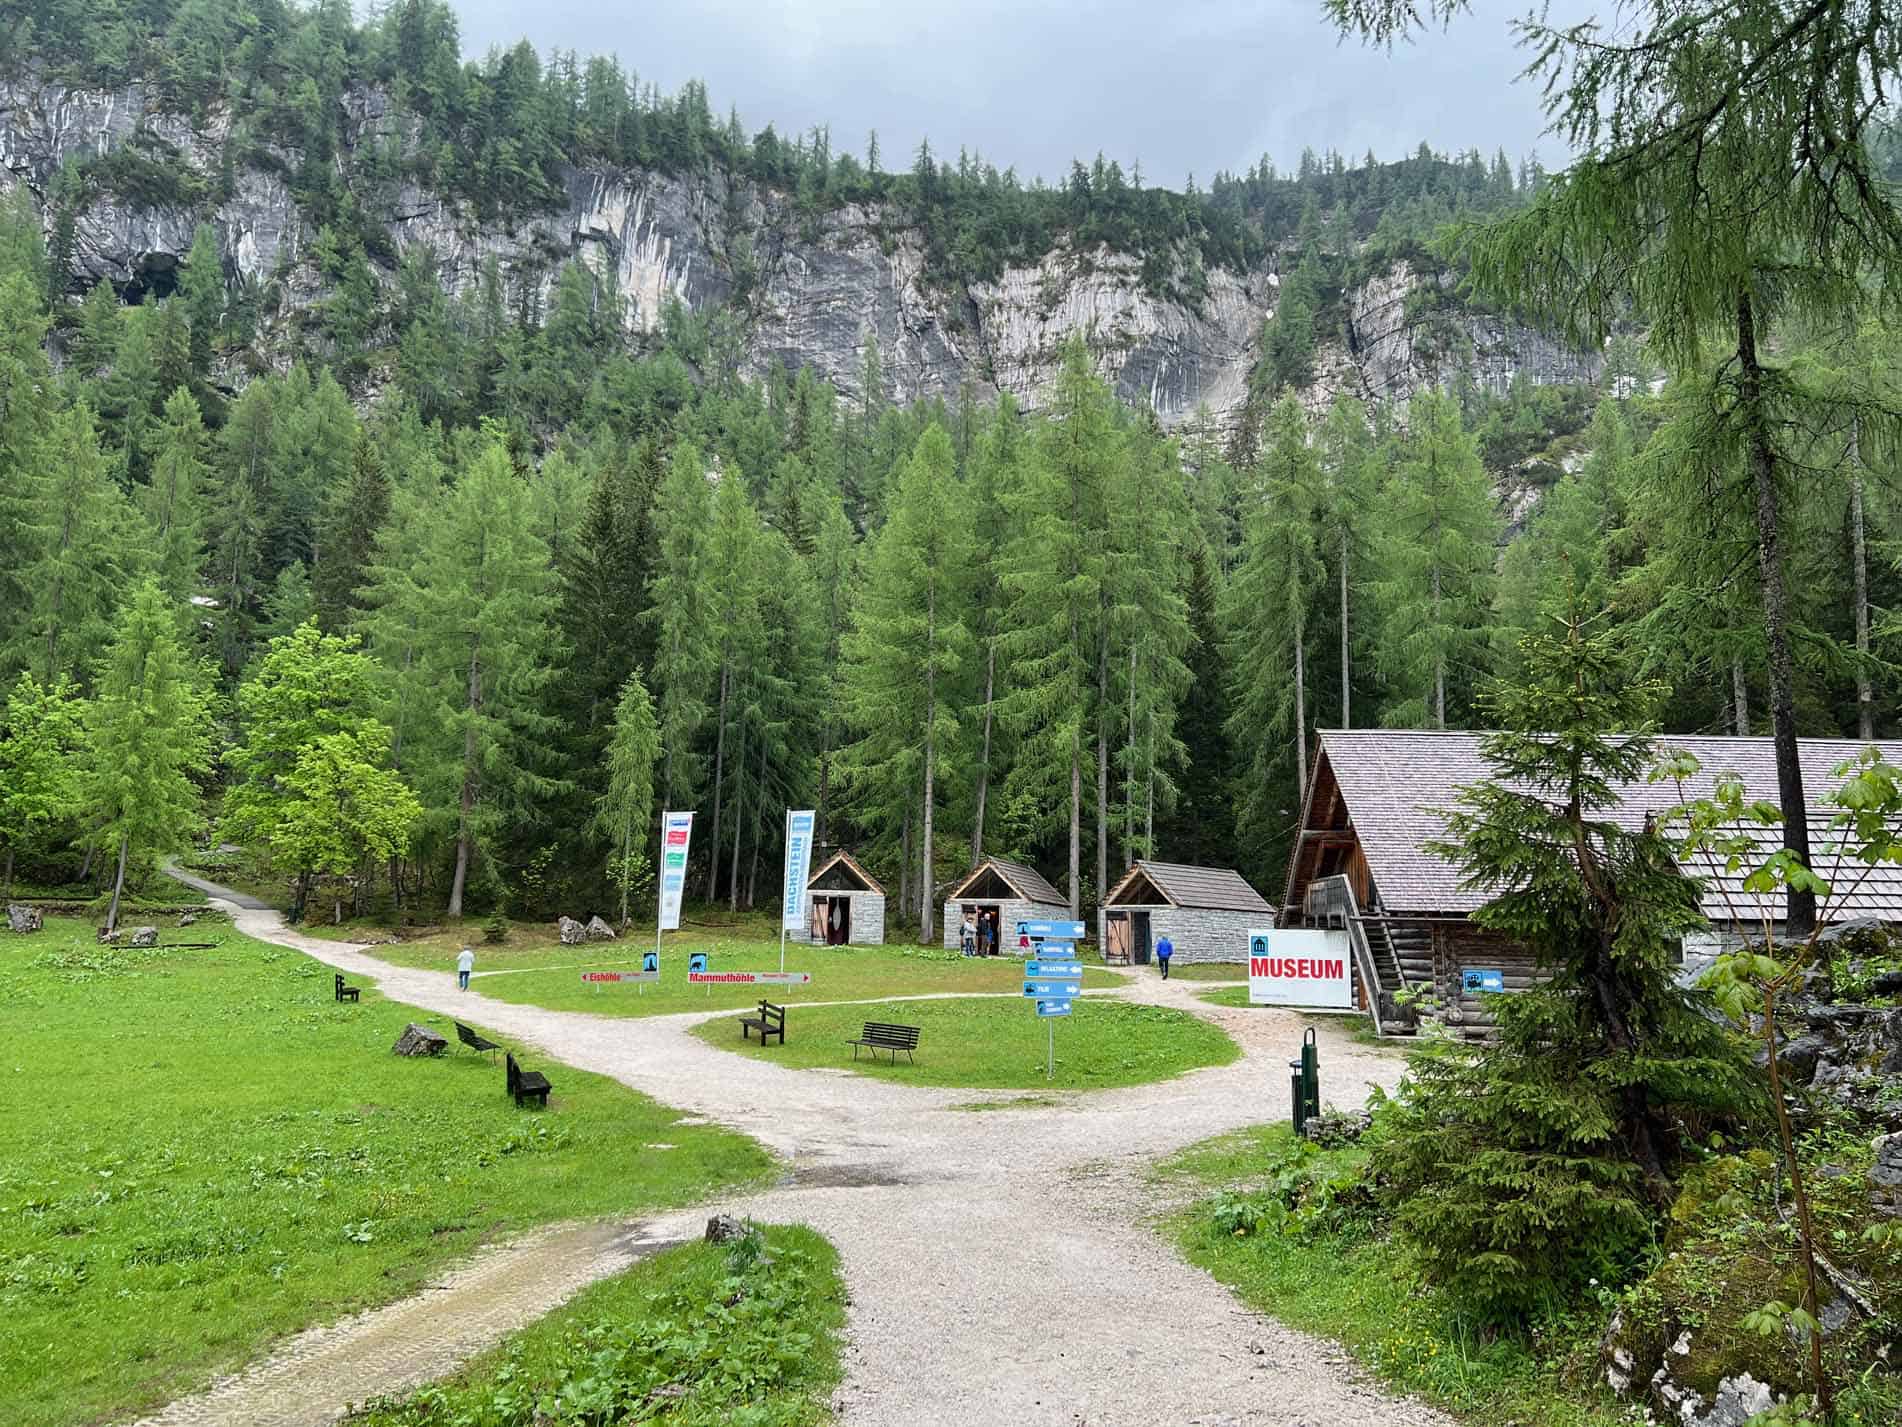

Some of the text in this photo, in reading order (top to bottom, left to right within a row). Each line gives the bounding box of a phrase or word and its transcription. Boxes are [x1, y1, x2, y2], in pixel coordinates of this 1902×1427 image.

[787, 837, 803, 915] DACHSTEIN
[1250, 957, 1344, 979] MUSEUM
[589, 971, 621, 982] Eishöhle
[688, 972, 756, 983] Mammuthöhle
